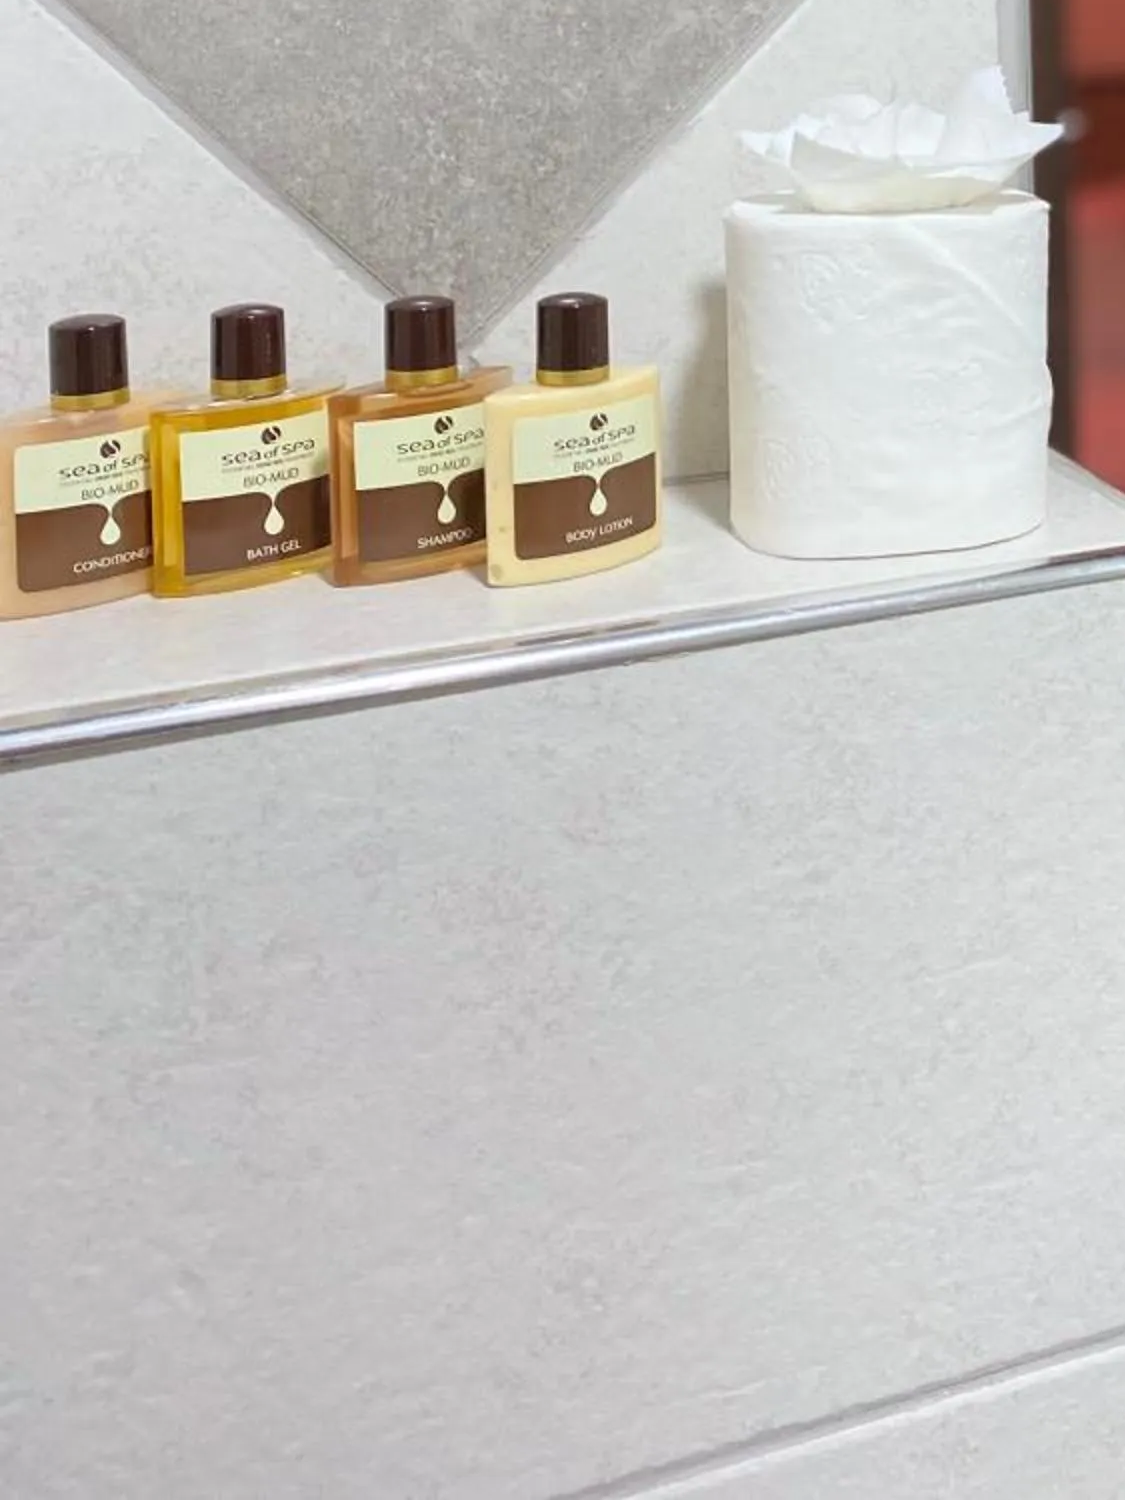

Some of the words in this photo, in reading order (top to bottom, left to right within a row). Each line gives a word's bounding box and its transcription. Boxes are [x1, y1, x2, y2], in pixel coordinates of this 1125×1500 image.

[396, 438, 435, 454] sea
[437, 435, 451, 449] of
[592, 431, 606, 446] of
[221, 449, 261, 467] sea
[263, 445, 279, 459] of
[59, 462, 100, 479] sea
[103, 459, 117, 473] of
[416, 526, 473, 549] SHAMPOO
[565, 526, 598, 544] BODY
[599, 515, 634, 535] LOTION
[246, 544, 278, 560] BATH
[281, 539, 302, 552] GEL
